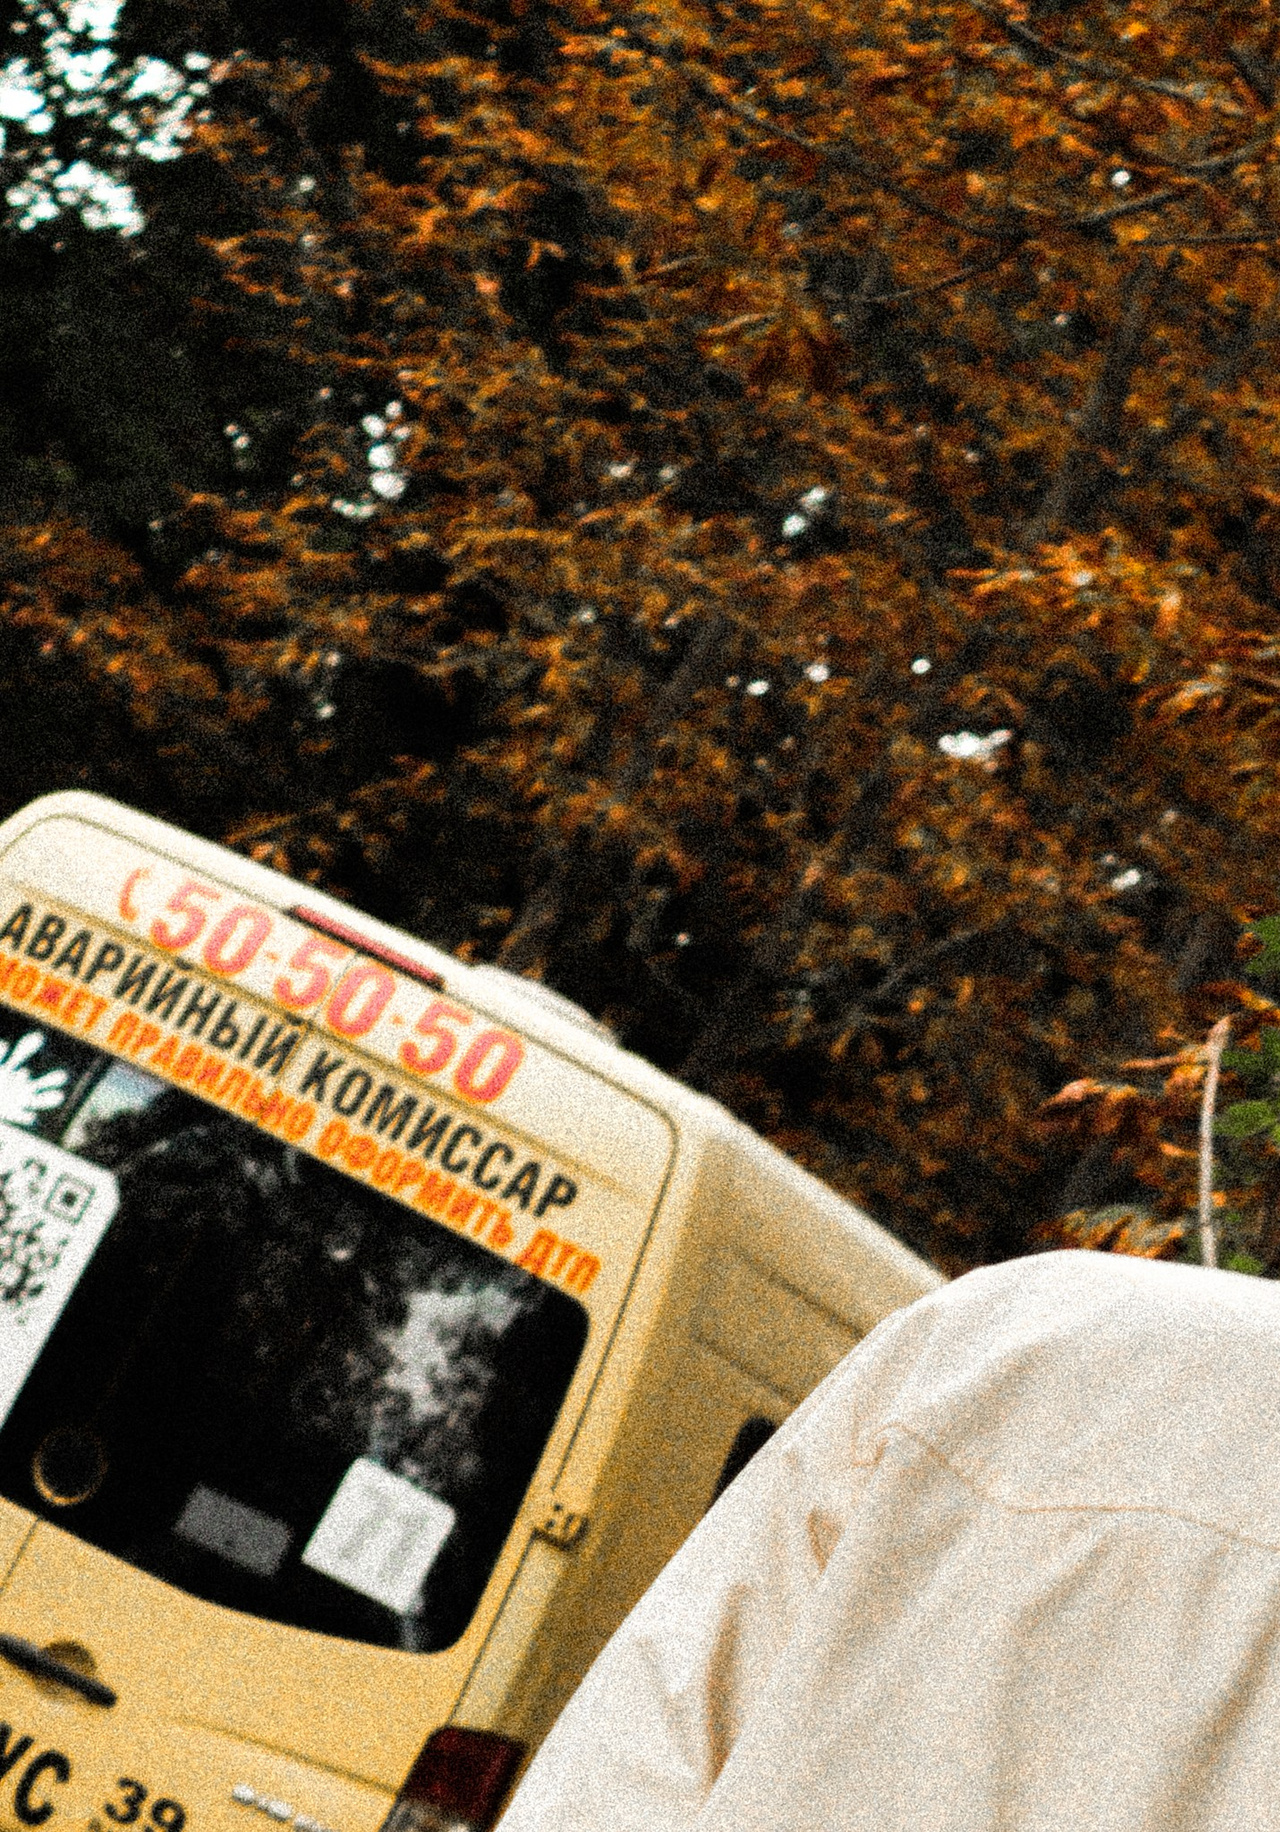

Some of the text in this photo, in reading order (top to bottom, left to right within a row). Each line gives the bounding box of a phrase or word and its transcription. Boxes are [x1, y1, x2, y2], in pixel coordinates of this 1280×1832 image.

[0, 902, 579, 1218] АВАРИЙНЫЙ КОМИССАР
[106, 1011, 317, 1142] ПРАВИЛЬНО
[316, 1119, 514, 1249] ОФОРМИТЬ
[514, 1229, 601, 1293] ДТП
